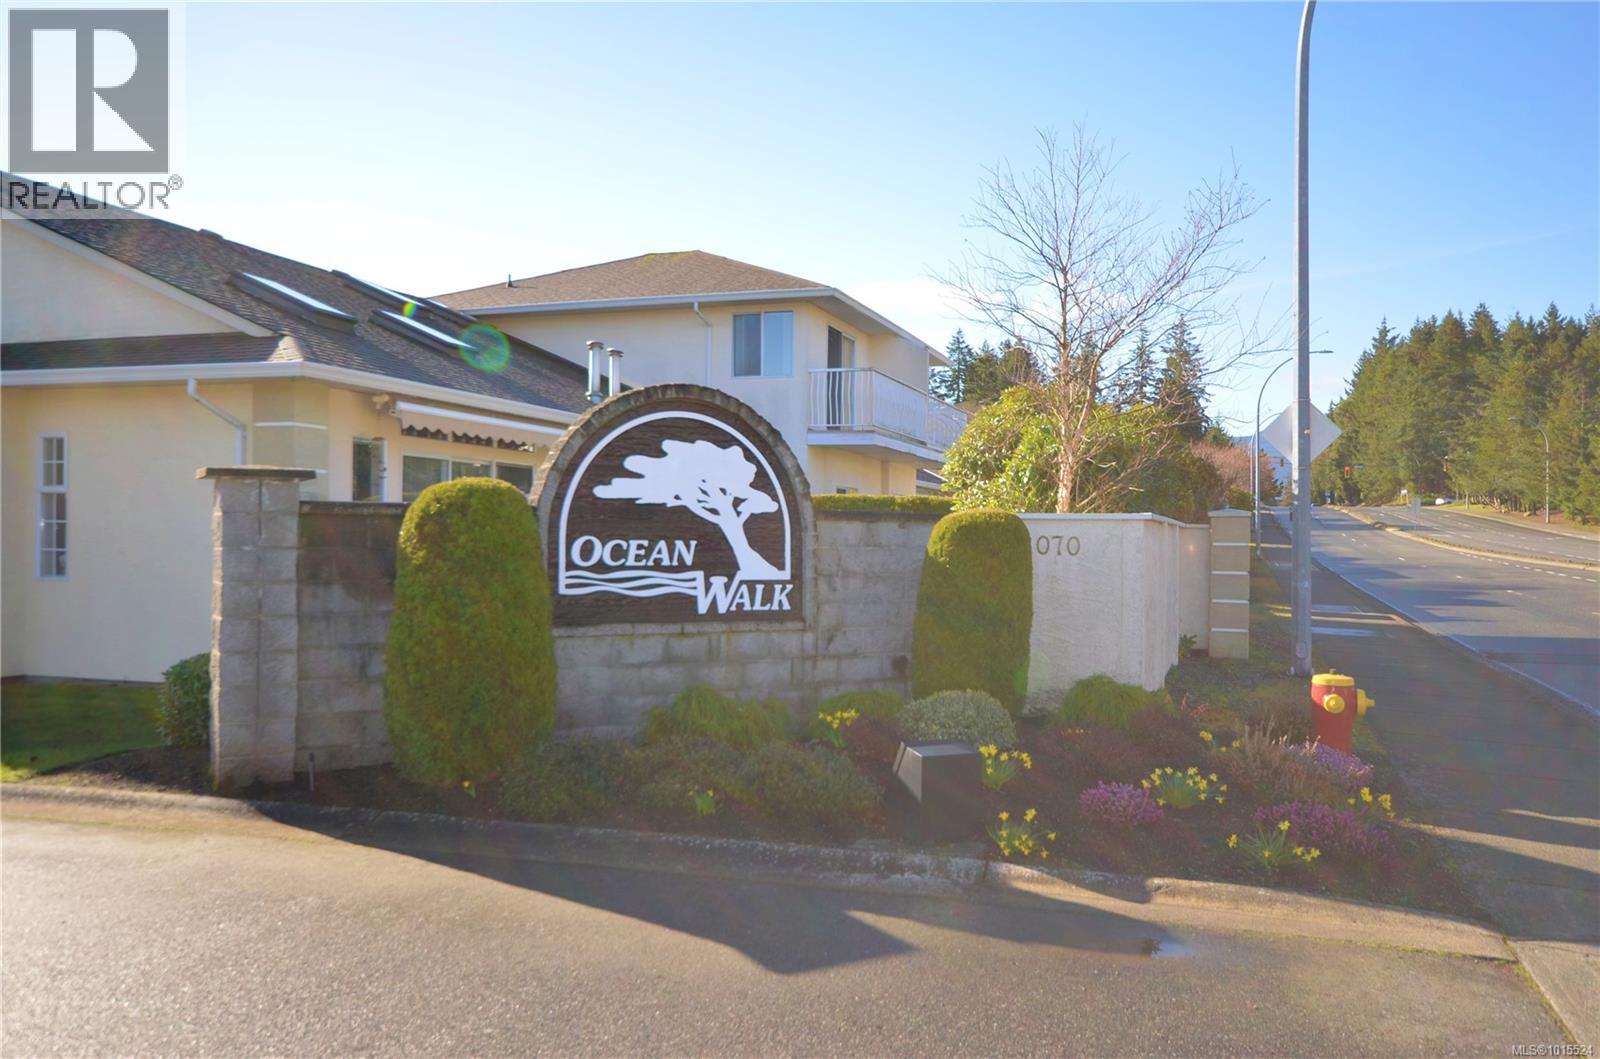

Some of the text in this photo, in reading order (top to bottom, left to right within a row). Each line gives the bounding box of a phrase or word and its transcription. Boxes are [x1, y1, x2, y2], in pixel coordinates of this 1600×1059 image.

[570, 535, 698, 567] OCEAN
[1036, 535, 1081, 556] 070
[696, 570, 794, 615] WALK
